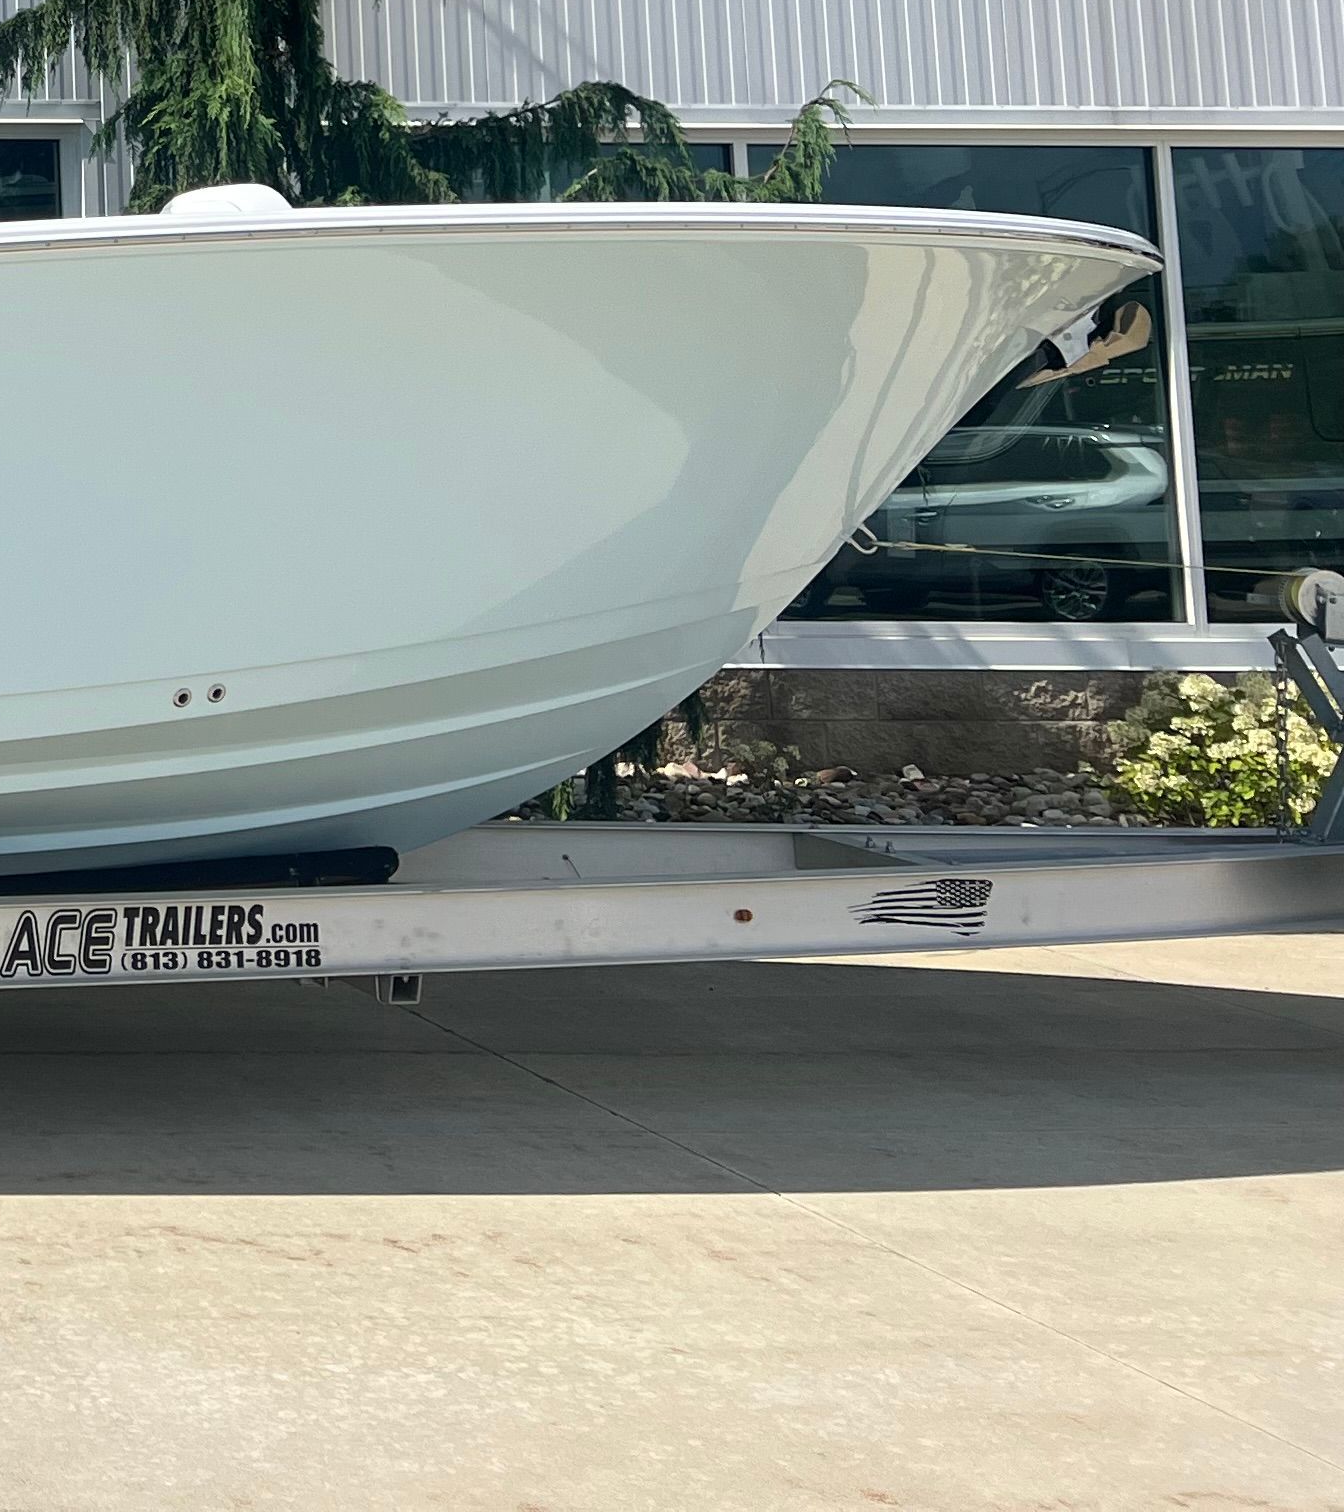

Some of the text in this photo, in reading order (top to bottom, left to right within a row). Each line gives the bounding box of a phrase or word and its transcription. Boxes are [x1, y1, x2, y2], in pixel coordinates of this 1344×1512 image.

[0, 907, 118, 978] ACE
[120, 948, 322, 972] (813) 831-8918
